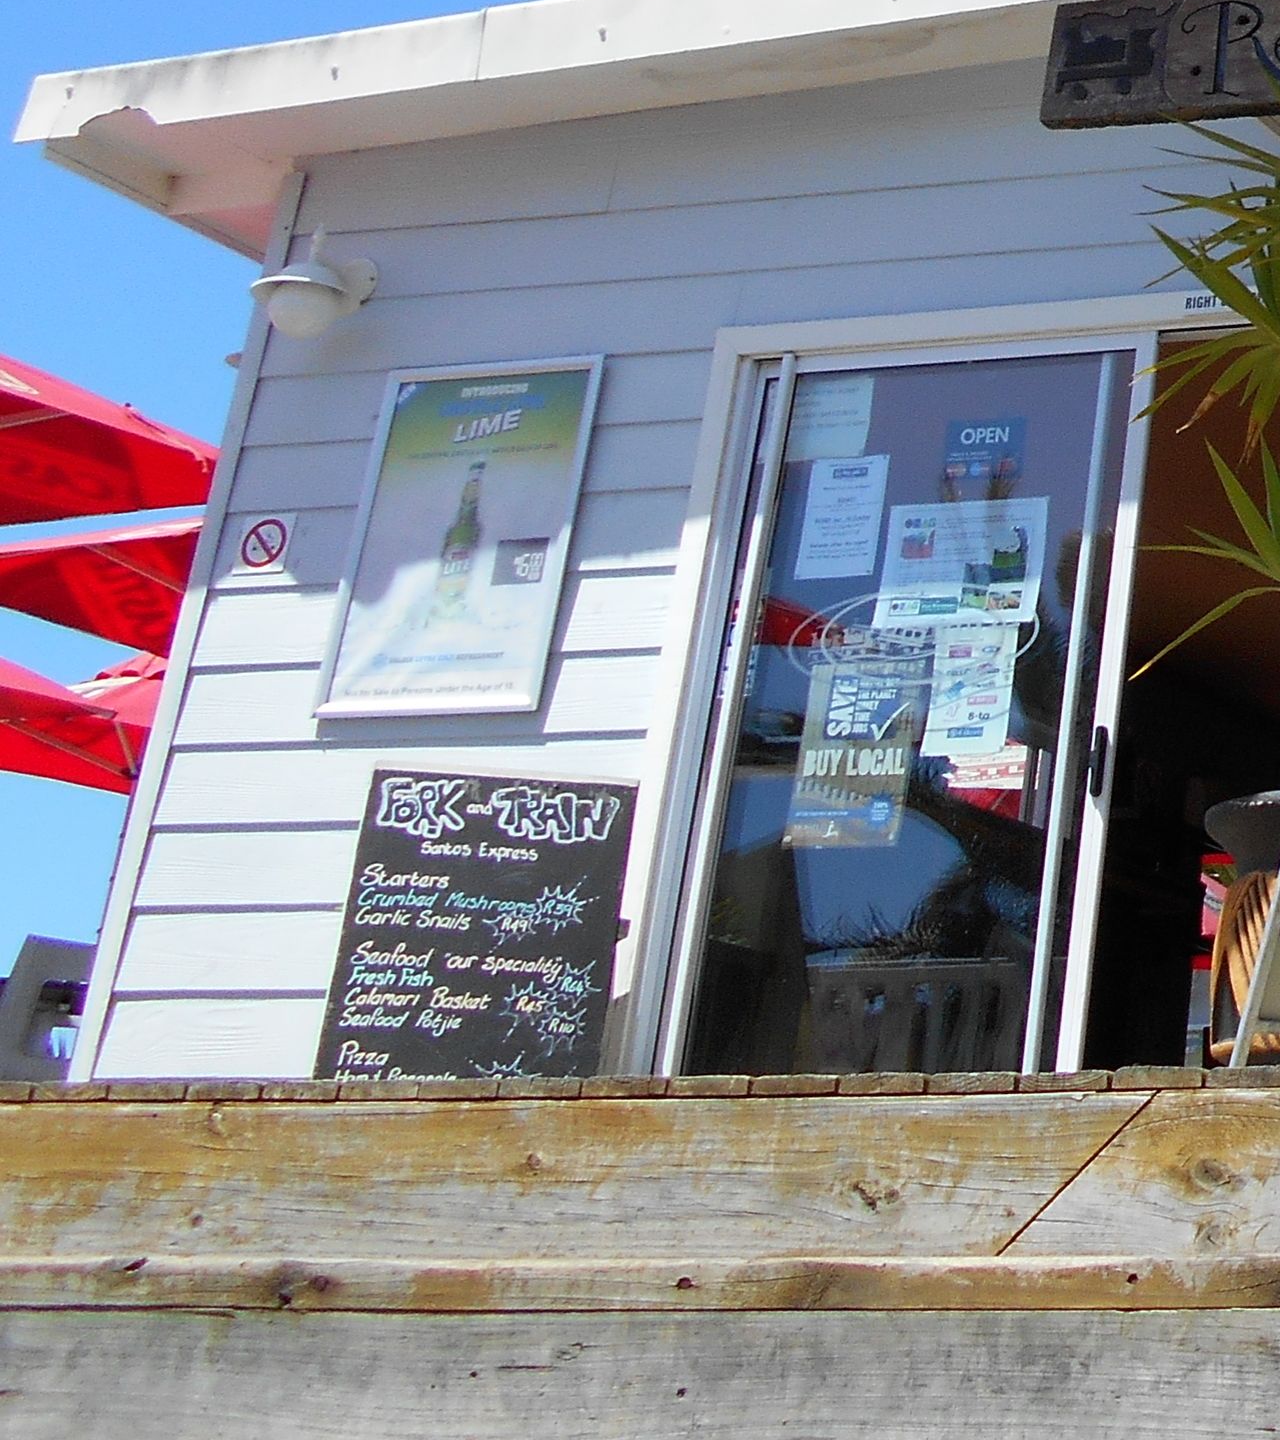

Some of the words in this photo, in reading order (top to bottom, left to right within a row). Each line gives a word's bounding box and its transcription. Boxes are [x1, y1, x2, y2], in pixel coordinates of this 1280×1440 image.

[1184, 294, 1218, 310] RIGHT
[453, 408, 523, 444] LIME
[960, 426, 1010, 445] OPEN
[826, 678, 858, 737] SAVE
[803, 749, 845, 777] BUY
[845, 747, 906, 776] LOCAL
[466, 801, 494, 816] and
[420, 840, 472, 857] Santos
[478, 842, 539, 862] Express
[358, 863, 450, 891] Starters
[357, 887, 439, 910] Crumbed
[444, 890, 537, 913] Mushrooms
[354, 908, 416, 926] Garlic
[417, 911, 471, 931] Snails
[350, 940, 435, 968] Seafood
[347, 966, 396, 986] Fresh
[398, 967, 434, 987] Fish
[344, 986, 421, 1007] Calamari
[429, 985, 493, 1010] Basket
[338, 1006, 410, 1028] Seafood
[415, 1009, 464, 1037] Potjie
[336, 1040, 391, 1067] Pizza
